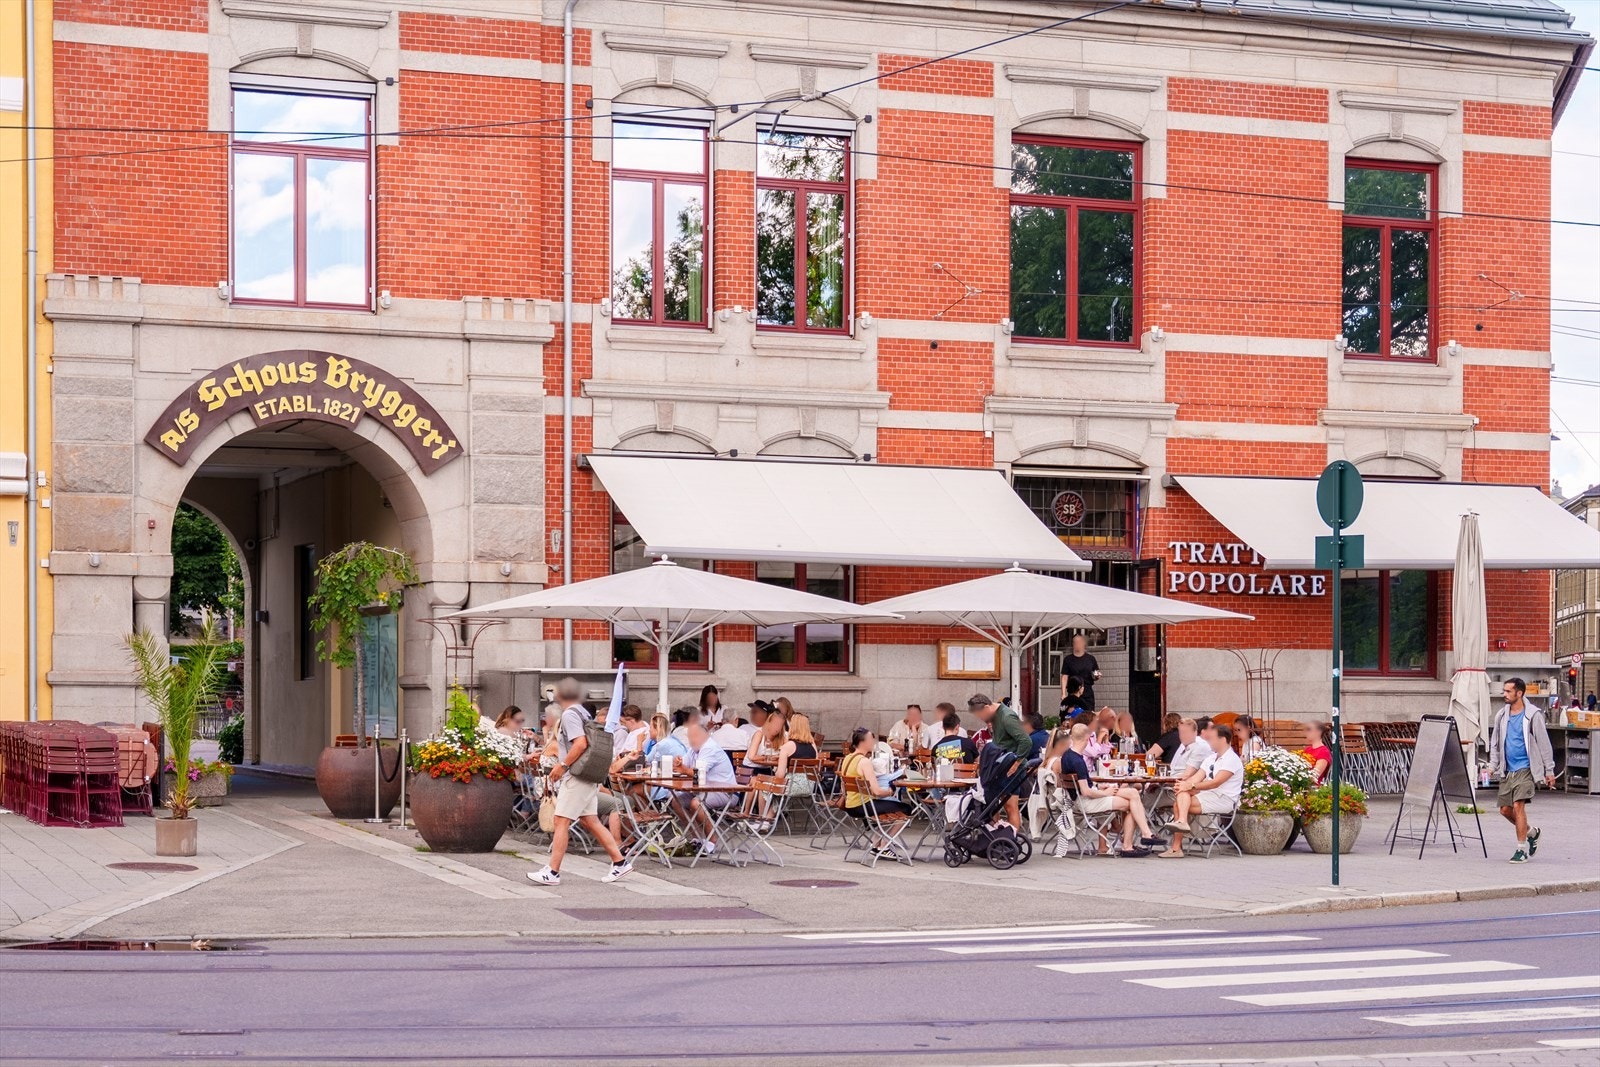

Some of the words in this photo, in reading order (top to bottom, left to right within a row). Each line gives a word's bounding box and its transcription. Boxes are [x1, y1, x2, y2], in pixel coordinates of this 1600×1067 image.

[198, 361, 317, 412] Schous
[323, 355, 456, 460] Bryggeri
[1063, 504, 1076, 515] SB
[1168, 571, 1326, 596] POPOLARE
